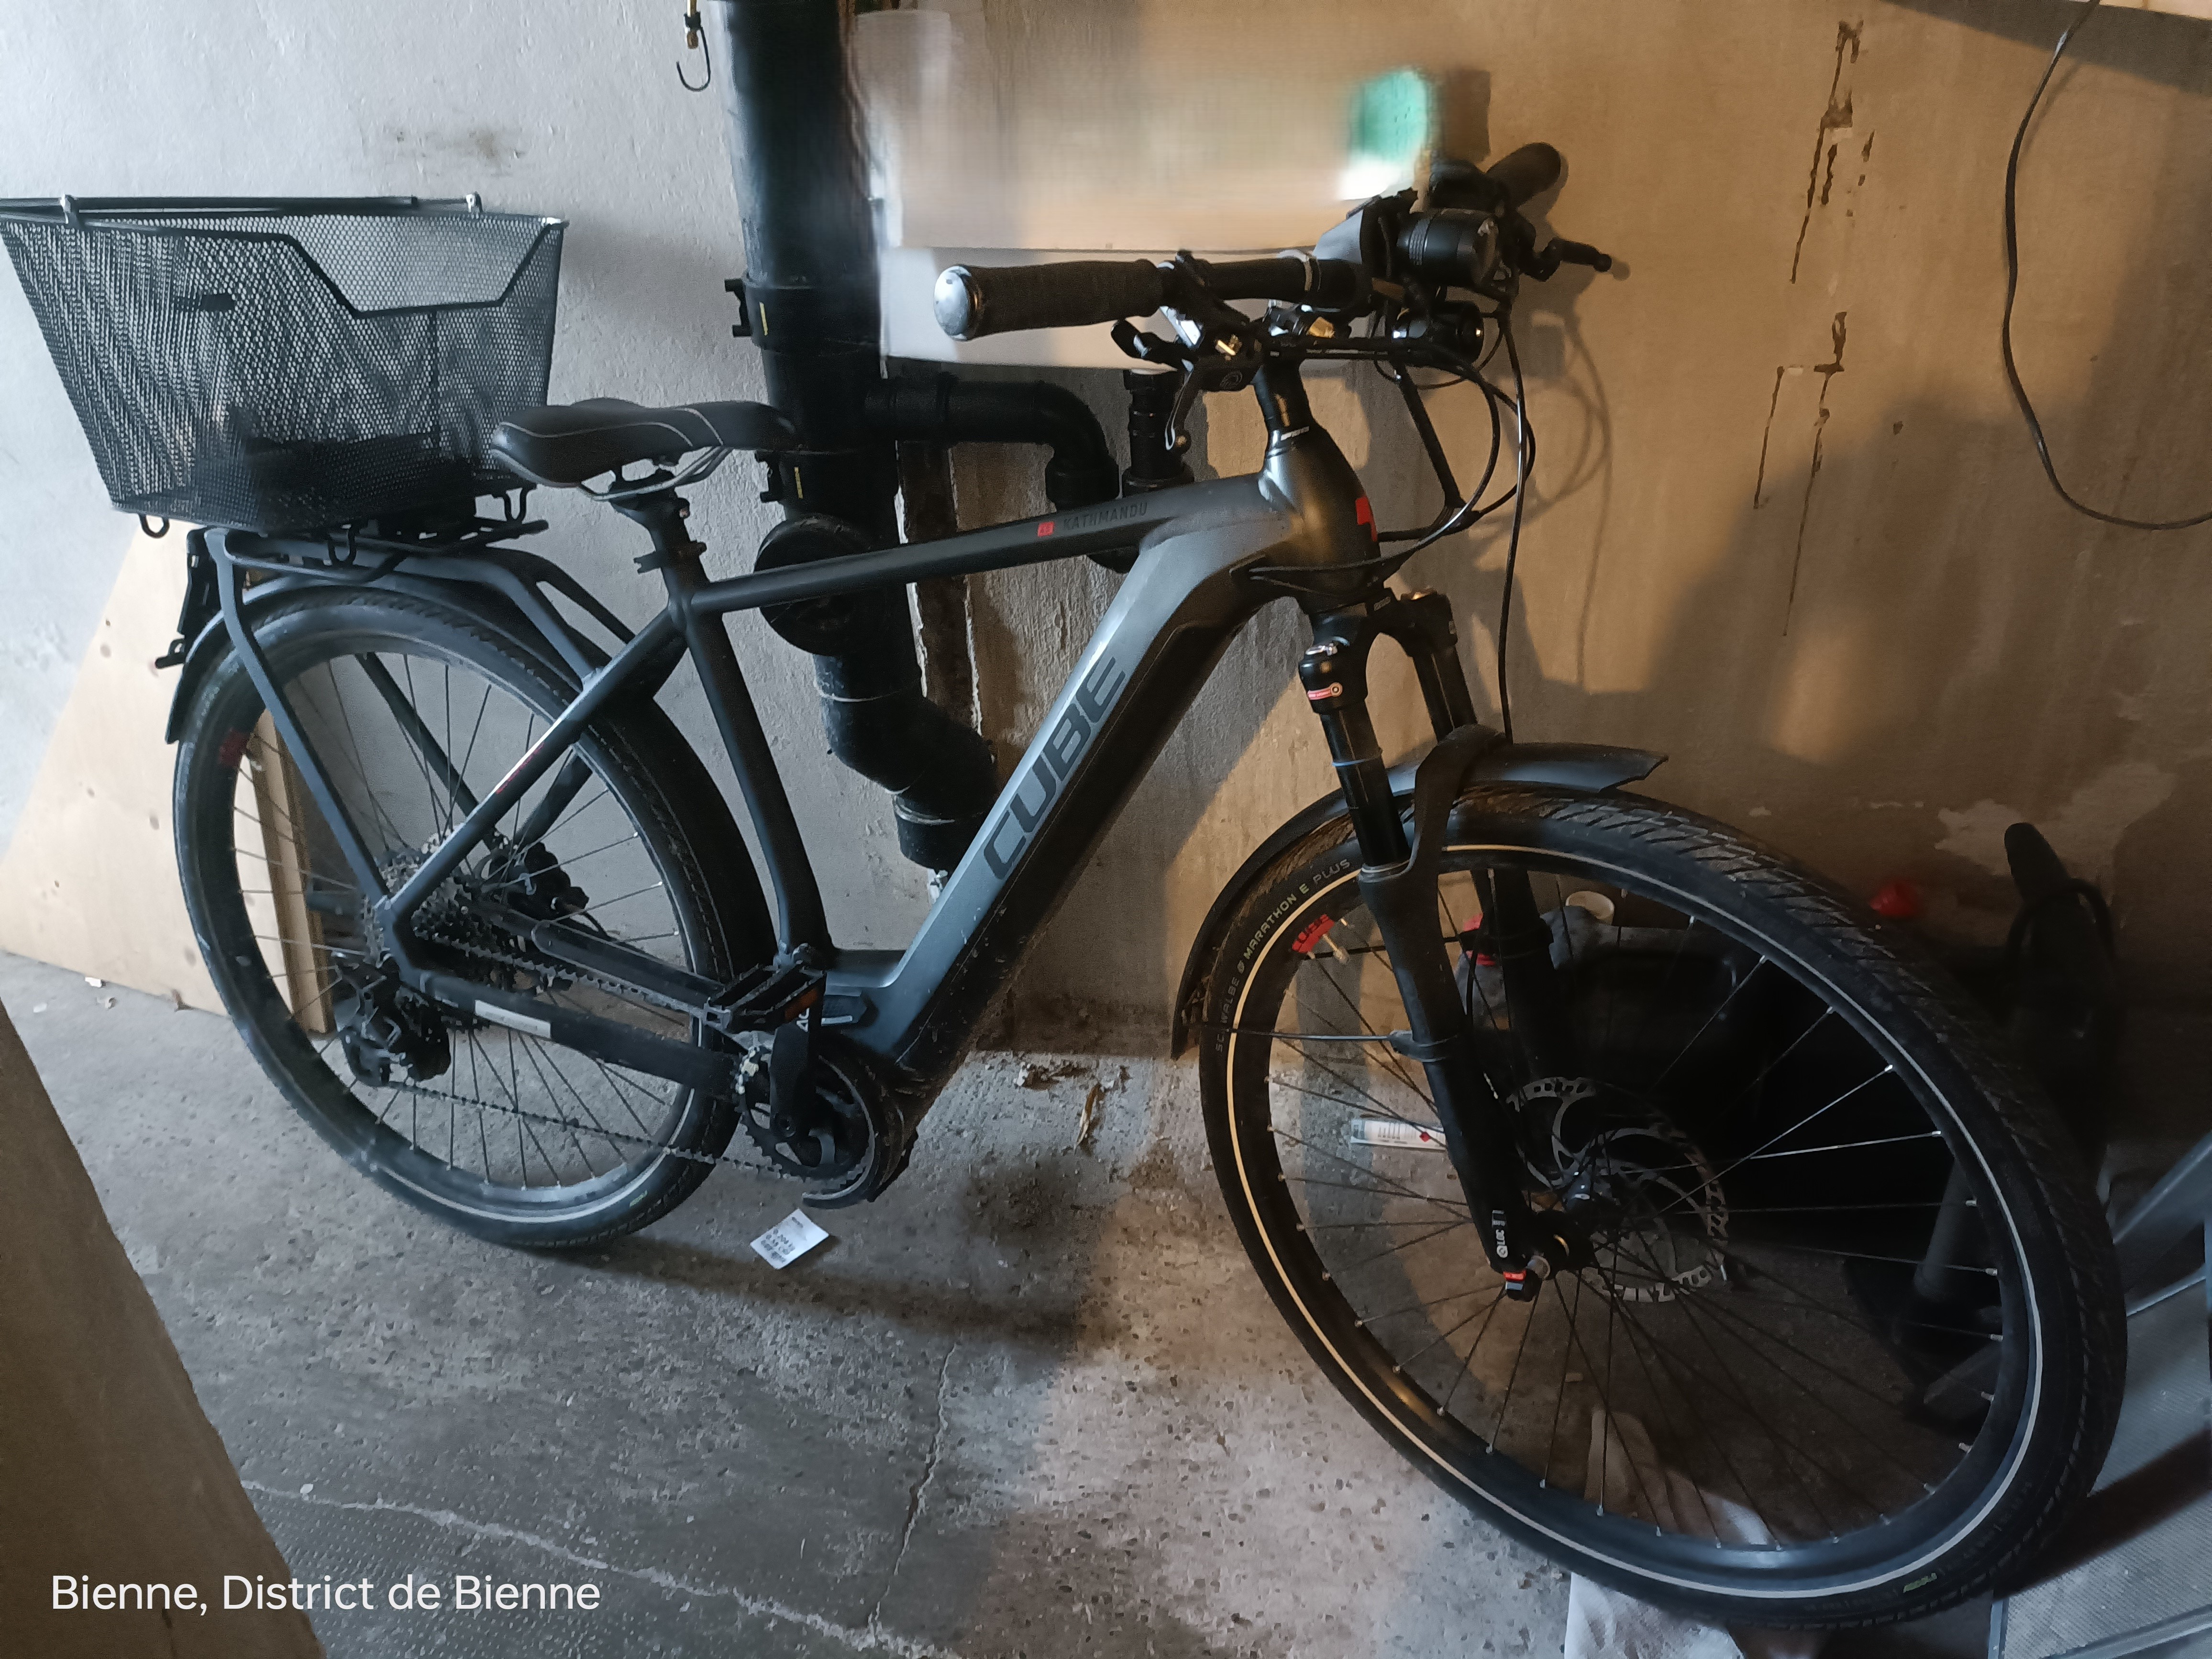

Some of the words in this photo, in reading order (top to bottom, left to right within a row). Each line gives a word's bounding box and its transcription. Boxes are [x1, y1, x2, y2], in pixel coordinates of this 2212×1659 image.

[1063, 502, 1148, 531] KATHMANDU
[984, 657, 1126, 880] CUBE
[1215, 976, 1240, 1053] SCWALBE
[1243, 893, 1297, 960] MARATHON
[1298, 883, 1310, 895] E
[1312, 859, 1350, 885] PLUS
